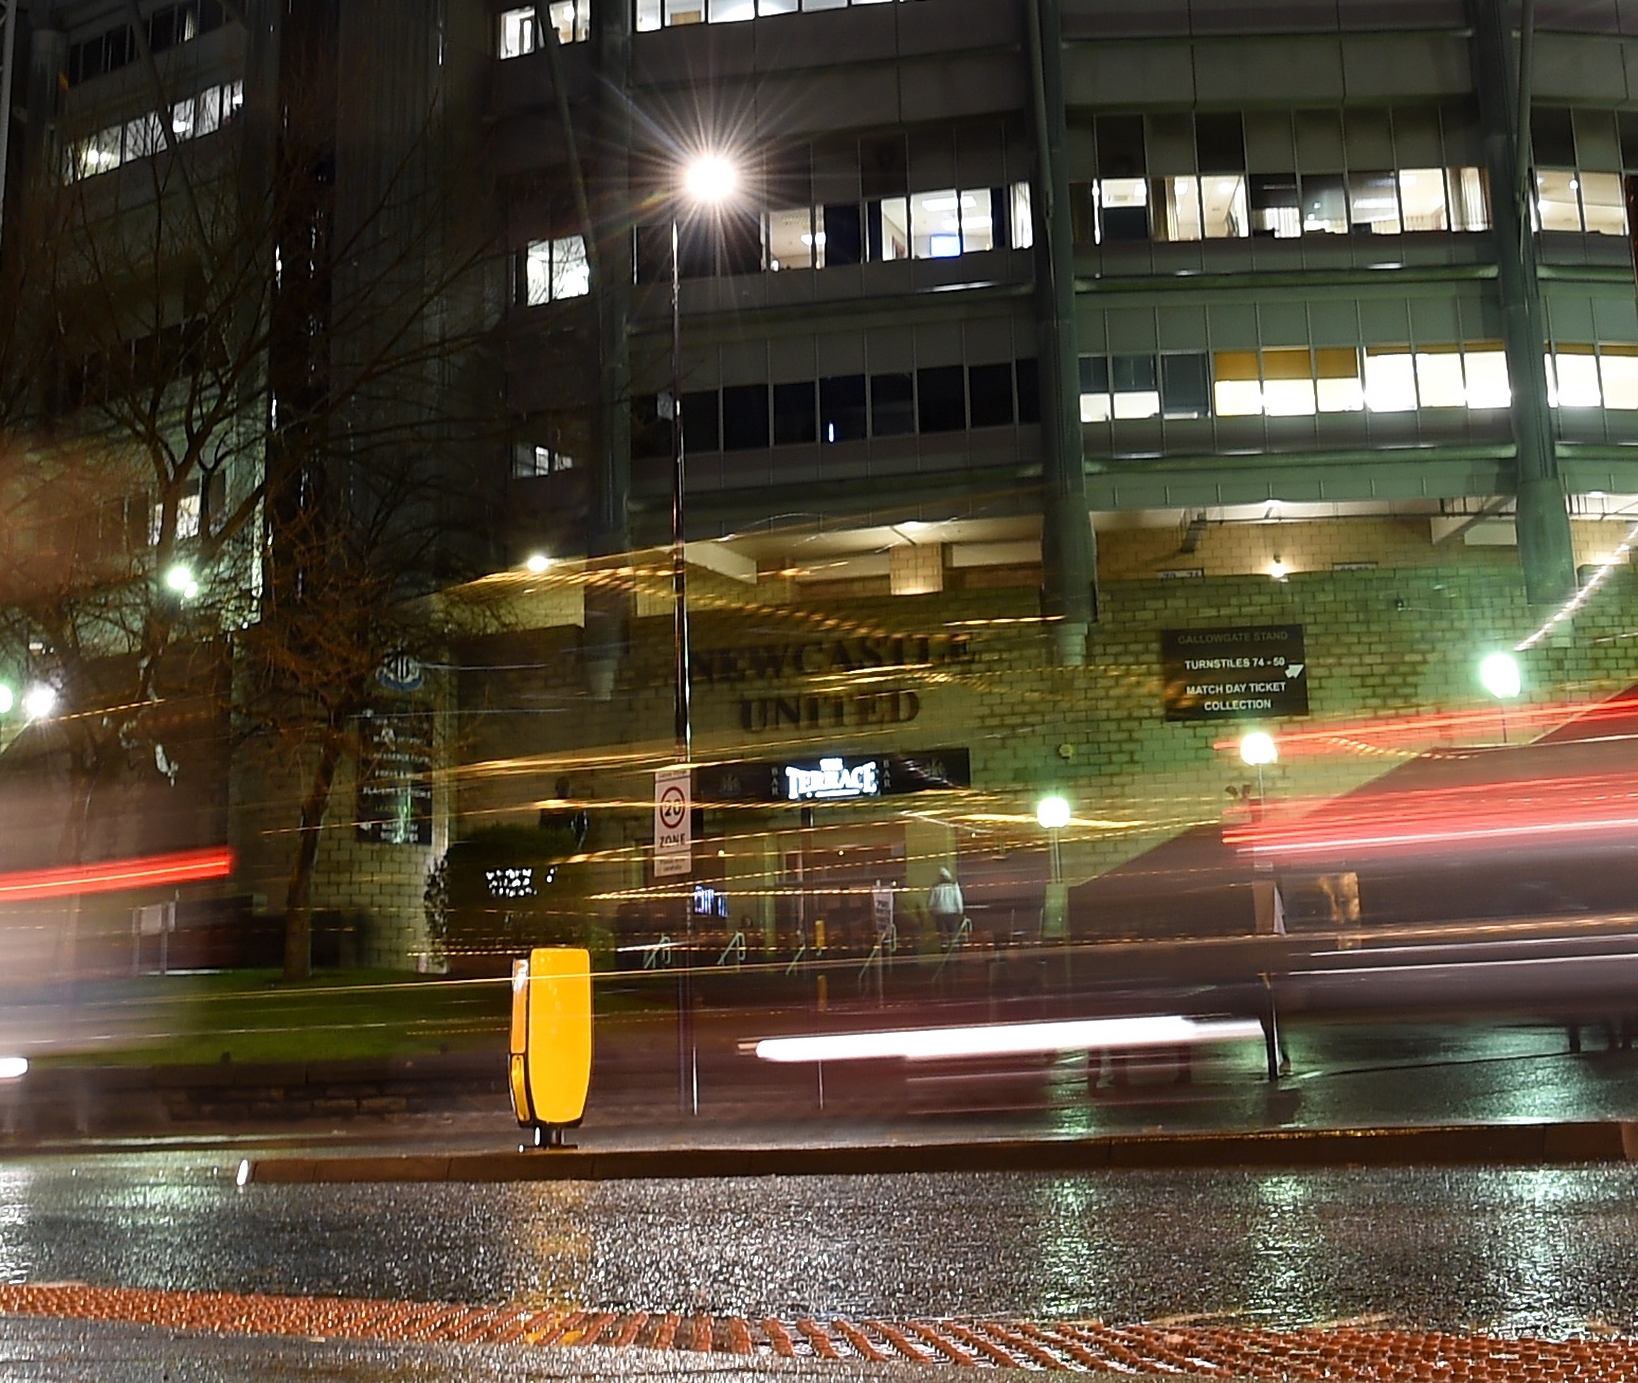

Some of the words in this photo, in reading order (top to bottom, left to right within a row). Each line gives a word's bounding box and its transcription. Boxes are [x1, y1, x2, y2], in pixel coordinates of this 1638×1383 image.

[1178, 633, 1250, 644] GALLOWGATE
[1253, 631, 1288, 641] STAND
[1185, 658, 1250, 670] TURNSTILES
[1252, 658, 1264, 667] 74
[1186, 684, 1223, 695] MATCH
[1225, 683, 1246, 693] DAY
[1249, 682, 1286, 692] TICKET
[738, 691, 920, 733] UNITED
[1204, 699, 1272, 711] COLLECTION
[883, 759, 891, 788] BAR
[664, 799, 682, 817] 20
[659, 833, 686, 848] ZONE
